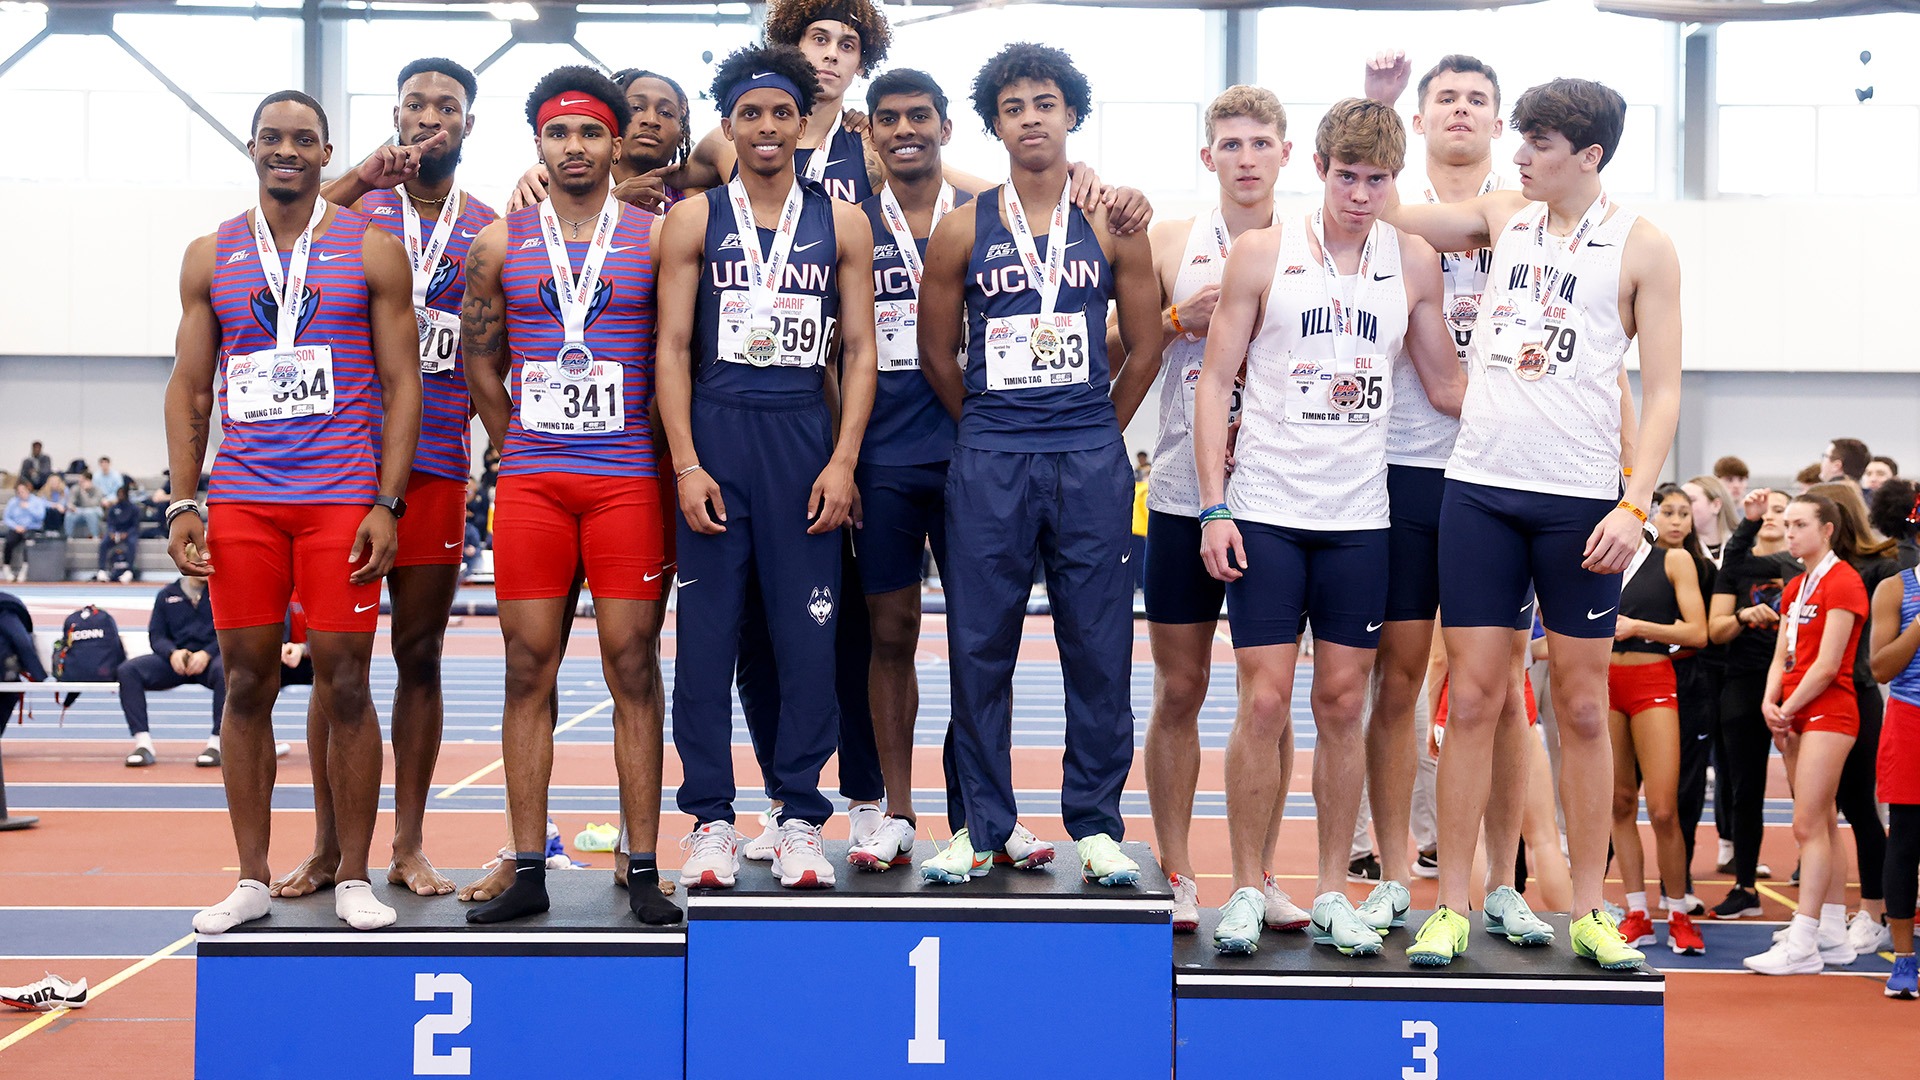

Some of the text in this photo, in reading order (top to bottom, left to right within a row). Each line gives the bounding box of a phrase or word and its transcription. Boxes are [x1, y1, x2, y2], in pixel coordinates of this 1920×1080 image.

[989, 242, 1012, 251] BIG
[985, 248, 1018, 259] EAST
[711, 260, 830, 292] UCNN
[976, 260, 1099, 298] UCNN
[1033, 266, 1045, 285] EAS
[773, 297, 805, 310] SHARIF
[1030, 315, 1073, 329] MONE
[1336, 314, 1344, 335] EAS
[770, 315, 817, 353] 259
[422, 327, 454, 360] 70
[295, 349, 315, 362] SON
[1490, 353, 1514, 365] TIMING
[233, 361, 252, 369] BIG
[890, 359, 913, 367] TIMING
[1354, 357, 1373, 369] EILL
[1003, 376, 1027, 385] TIMING
[1028, 376, 1042, 384] TAG
[563, 383, 616, 419] 341
[244, 409, 268, 419] TIMING
[269, 407, 283, 416] TAG
[1302, 412, 1326, 421] TIMING
[1327, 412, 1340, 421] TAG
[537, 422, 560, 430] TIMING
[561, 422, 575, 430] TAG
[907, 936, 946, 1064] 1
[413, 972, 473, 1076] 2
[1401, 1020, 1438, 1080] 3
